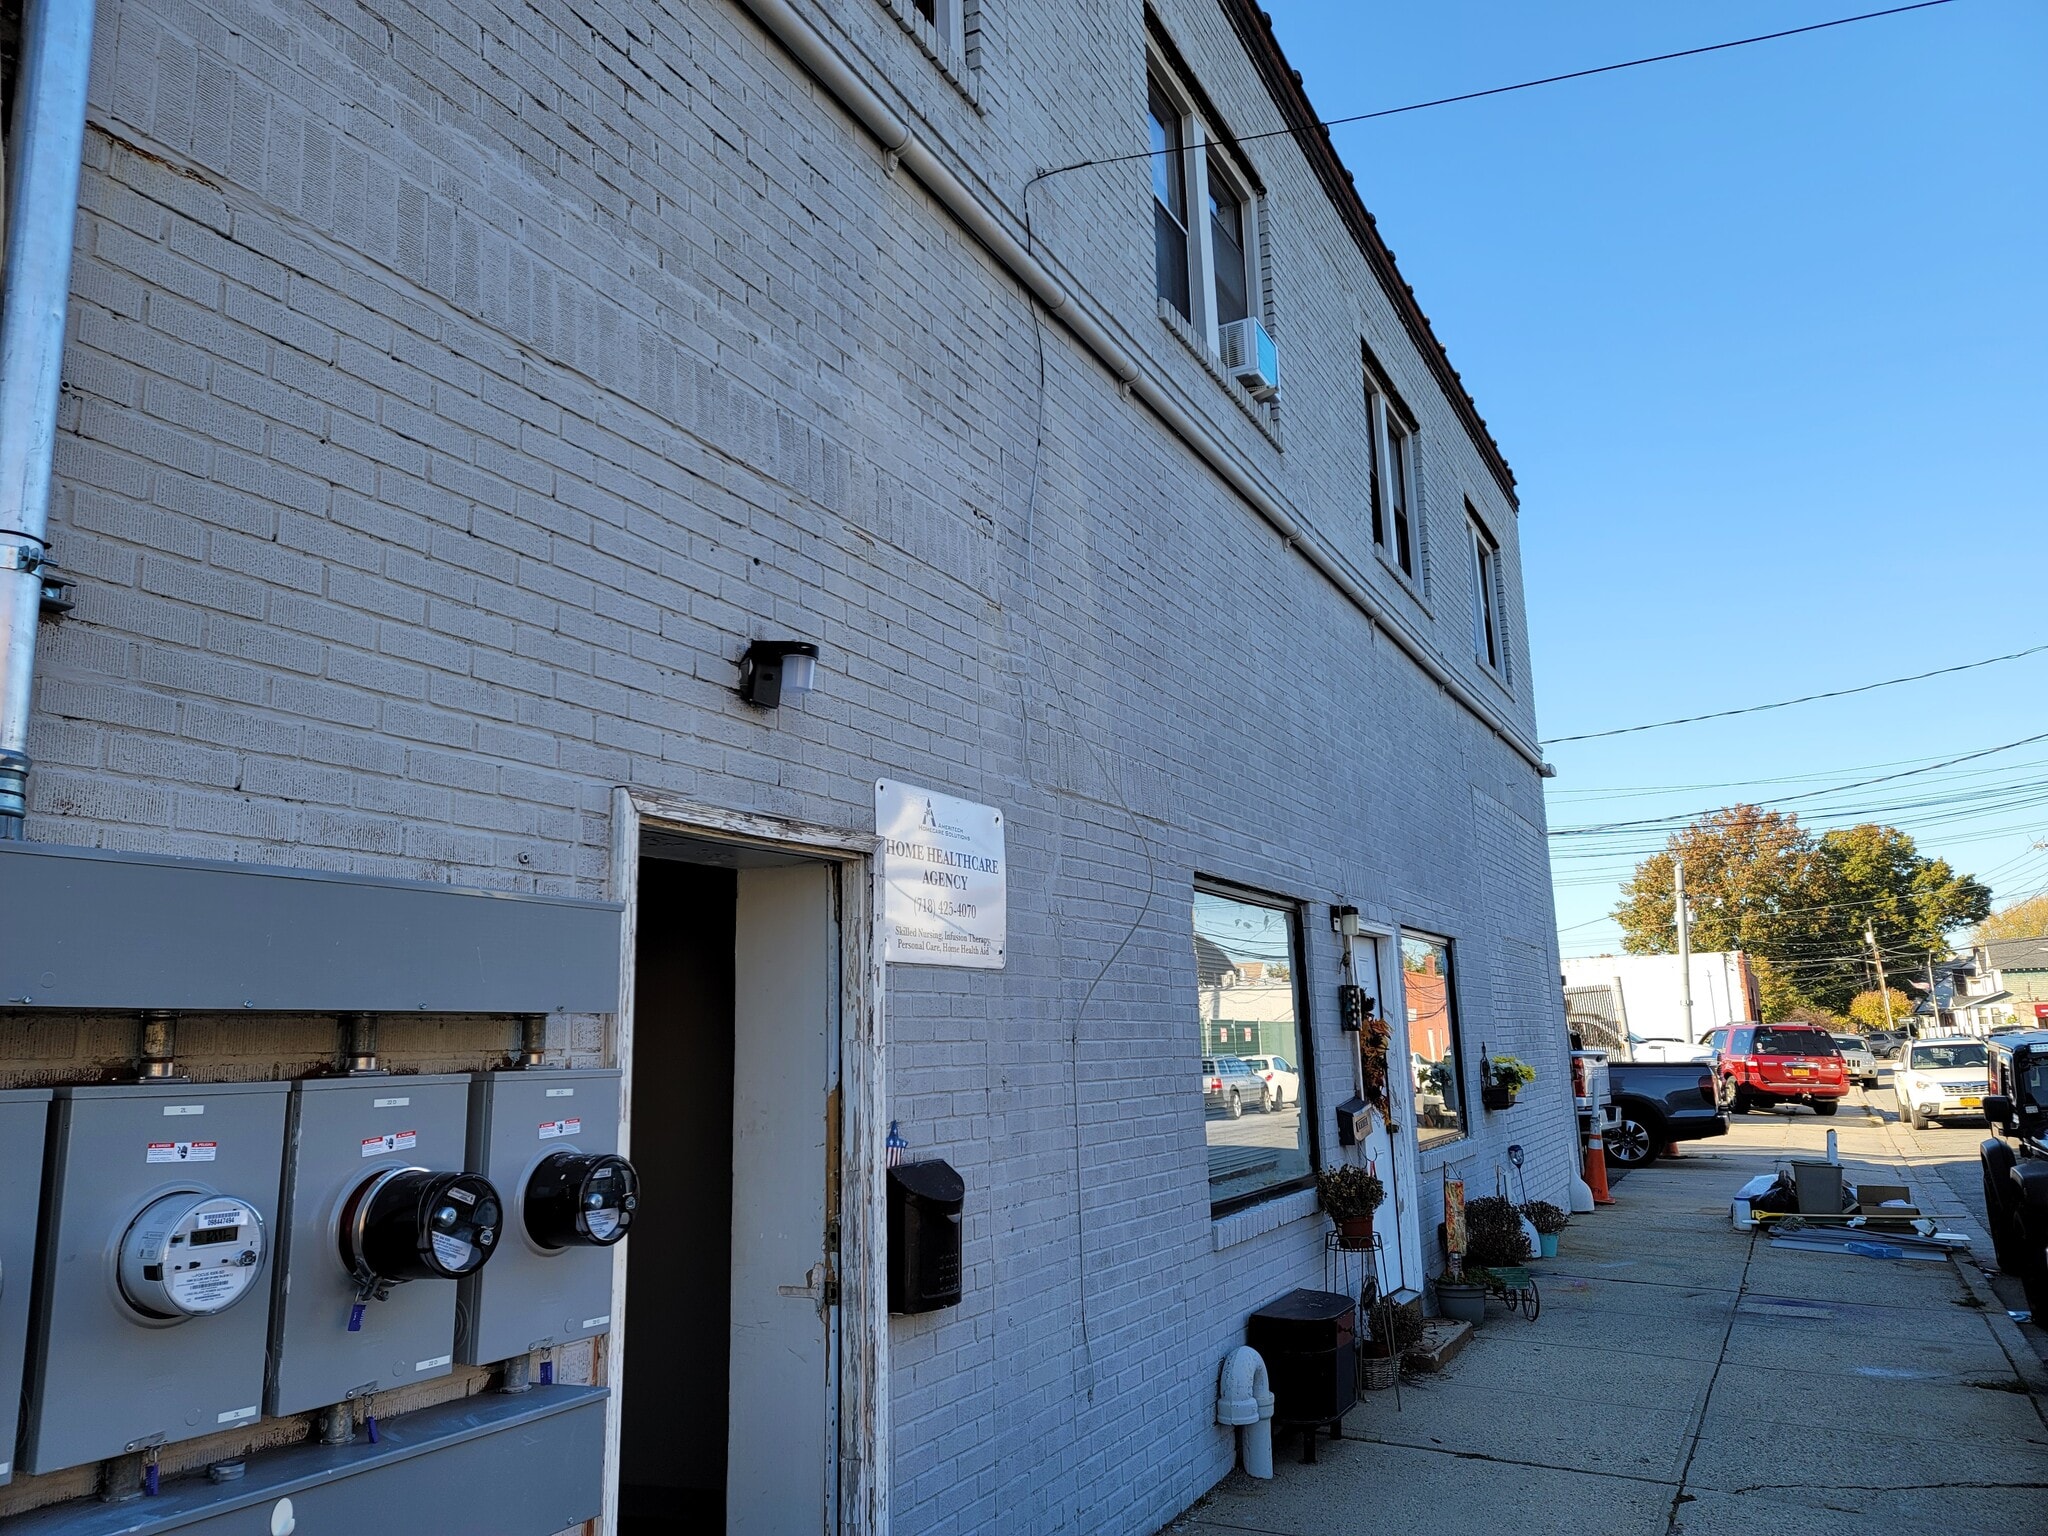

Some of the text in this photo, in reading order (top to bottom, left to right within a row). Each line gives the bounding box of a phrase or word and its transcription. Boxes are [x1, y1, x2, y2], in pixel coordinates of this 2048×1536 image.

[918, 824, 971, 841] HOMECARE SOLUTIONS
[886, 839, 998, 874] HOME HEALTHCARE
[922, 870, 968, 890] AGENCY
[914, 897, 977, 920] (718) 425-4070
[895, 926, 917, 938] Skilled
[918, 930, 943, 941] Nursing,
[944, 931, 967, 942] Infusion
[898, 940, 989, 956] Personal Care, Home Health Aid
